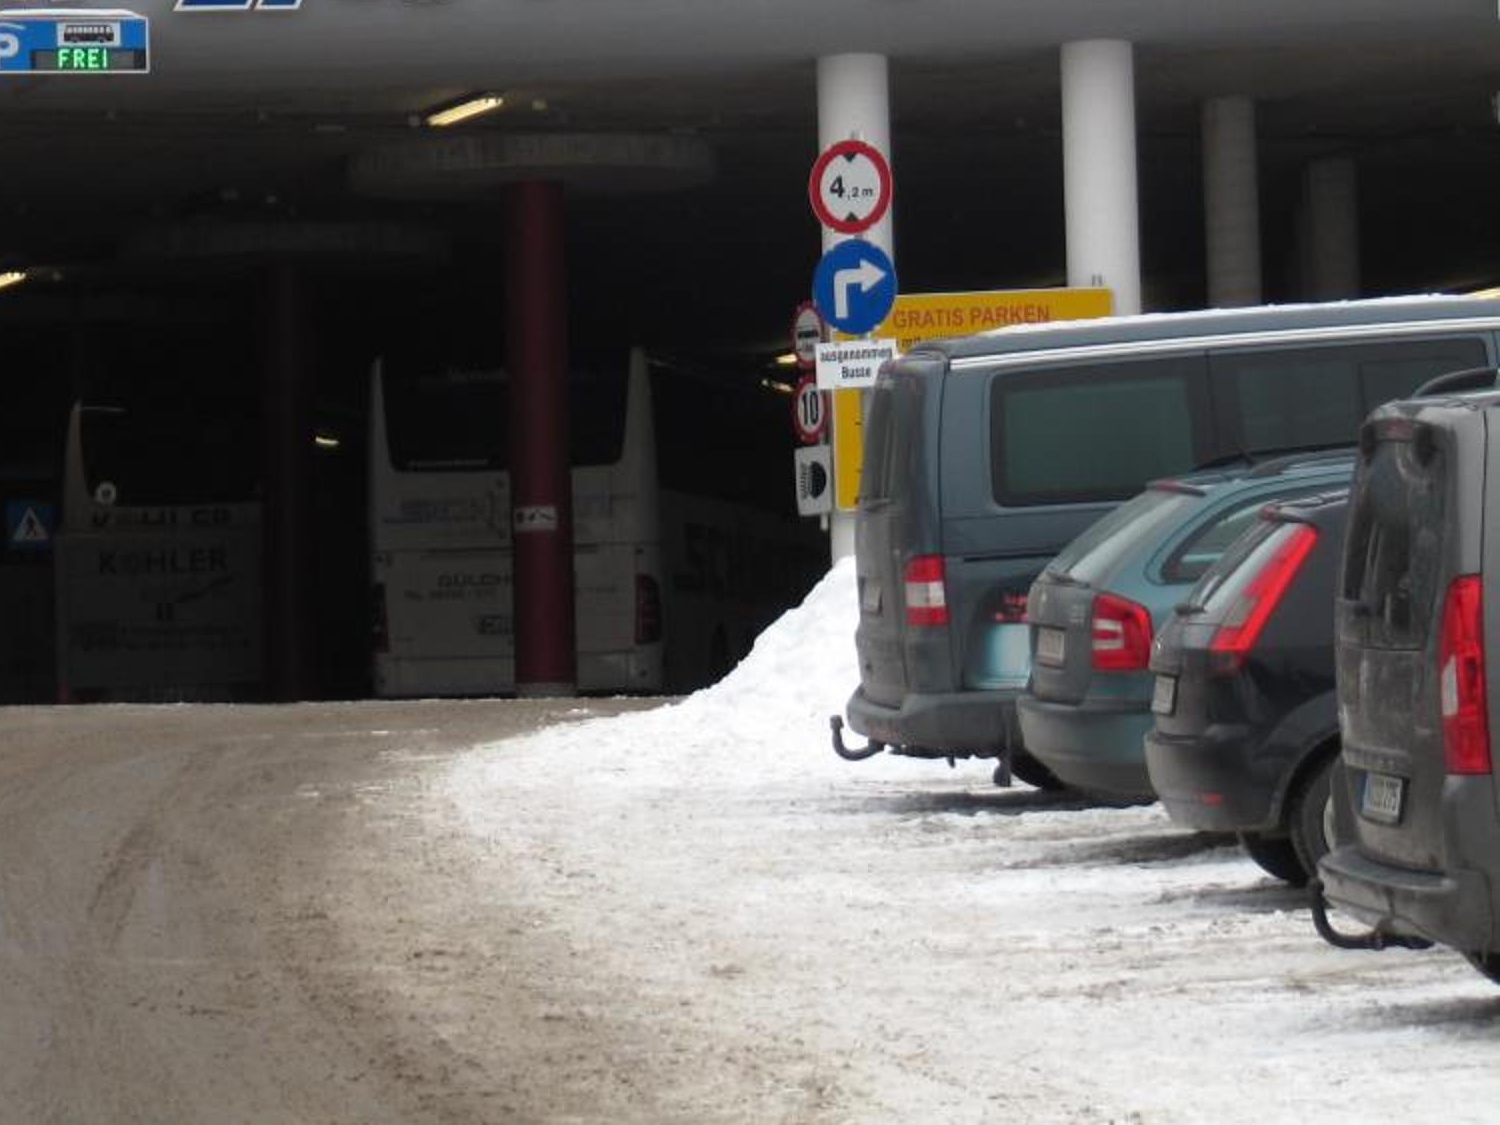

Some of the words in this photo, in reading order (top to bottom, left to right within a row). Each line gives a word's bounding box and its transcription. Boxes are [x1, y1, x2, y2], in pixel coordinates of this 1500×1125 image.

[57, 47, 108, 69] FREI
[893, 309, 964, 330] GRATIS
[970, 303, 1050, 325] PARKEN
[801, 390, 819, 425] 10
